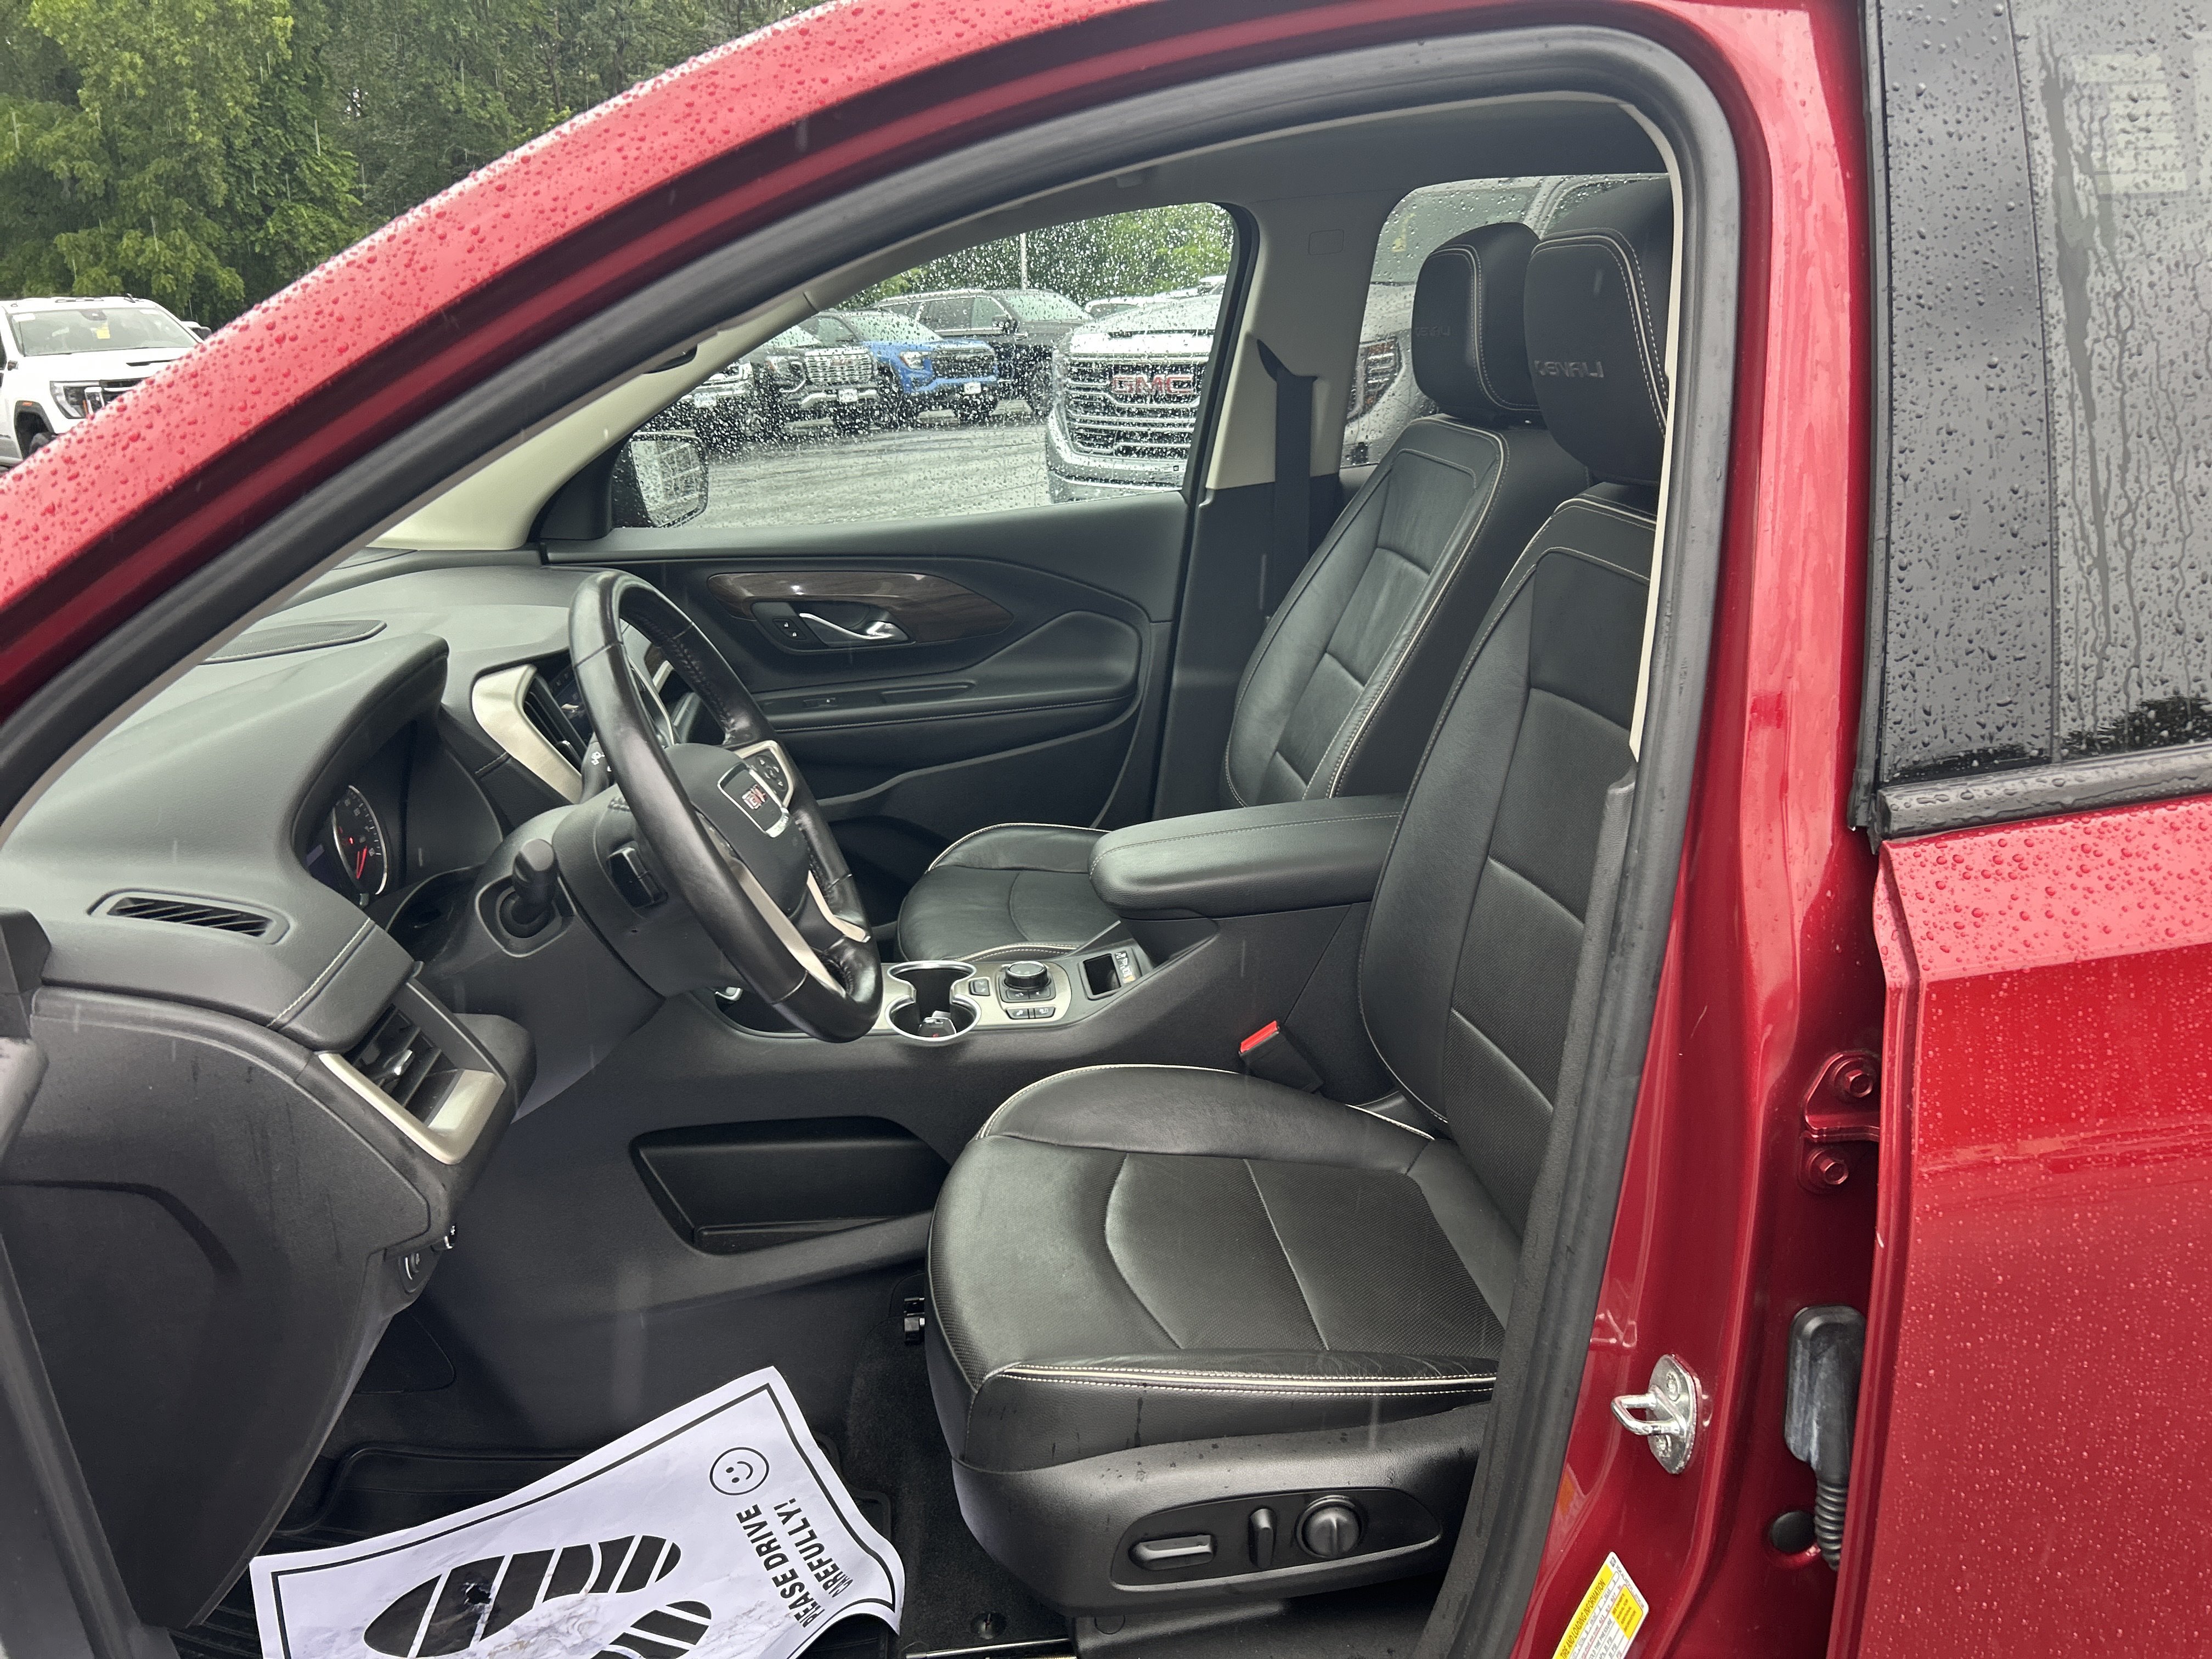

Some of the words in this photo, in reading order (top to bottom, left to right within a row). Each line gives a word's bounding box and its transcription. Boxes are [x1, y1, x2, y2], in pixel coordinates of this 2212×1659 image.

[1112, 374, 1194, 394] GMC
[1534, 360, 1604, 378] DENALI
[736, 1504, 789, 1571] DRIVE
[773, 1498, 854, 1598] CAREFULLY!
[771, 1568, 825, 1628] PLEASE
[1560, 1646, 1570, 1659] TIRE
[1566, 1635, 1575, 1650] AND
[1571, 1612, 1587, 1639] LOADING
[1583, 1578, 1606, 1617] INFORMATION
